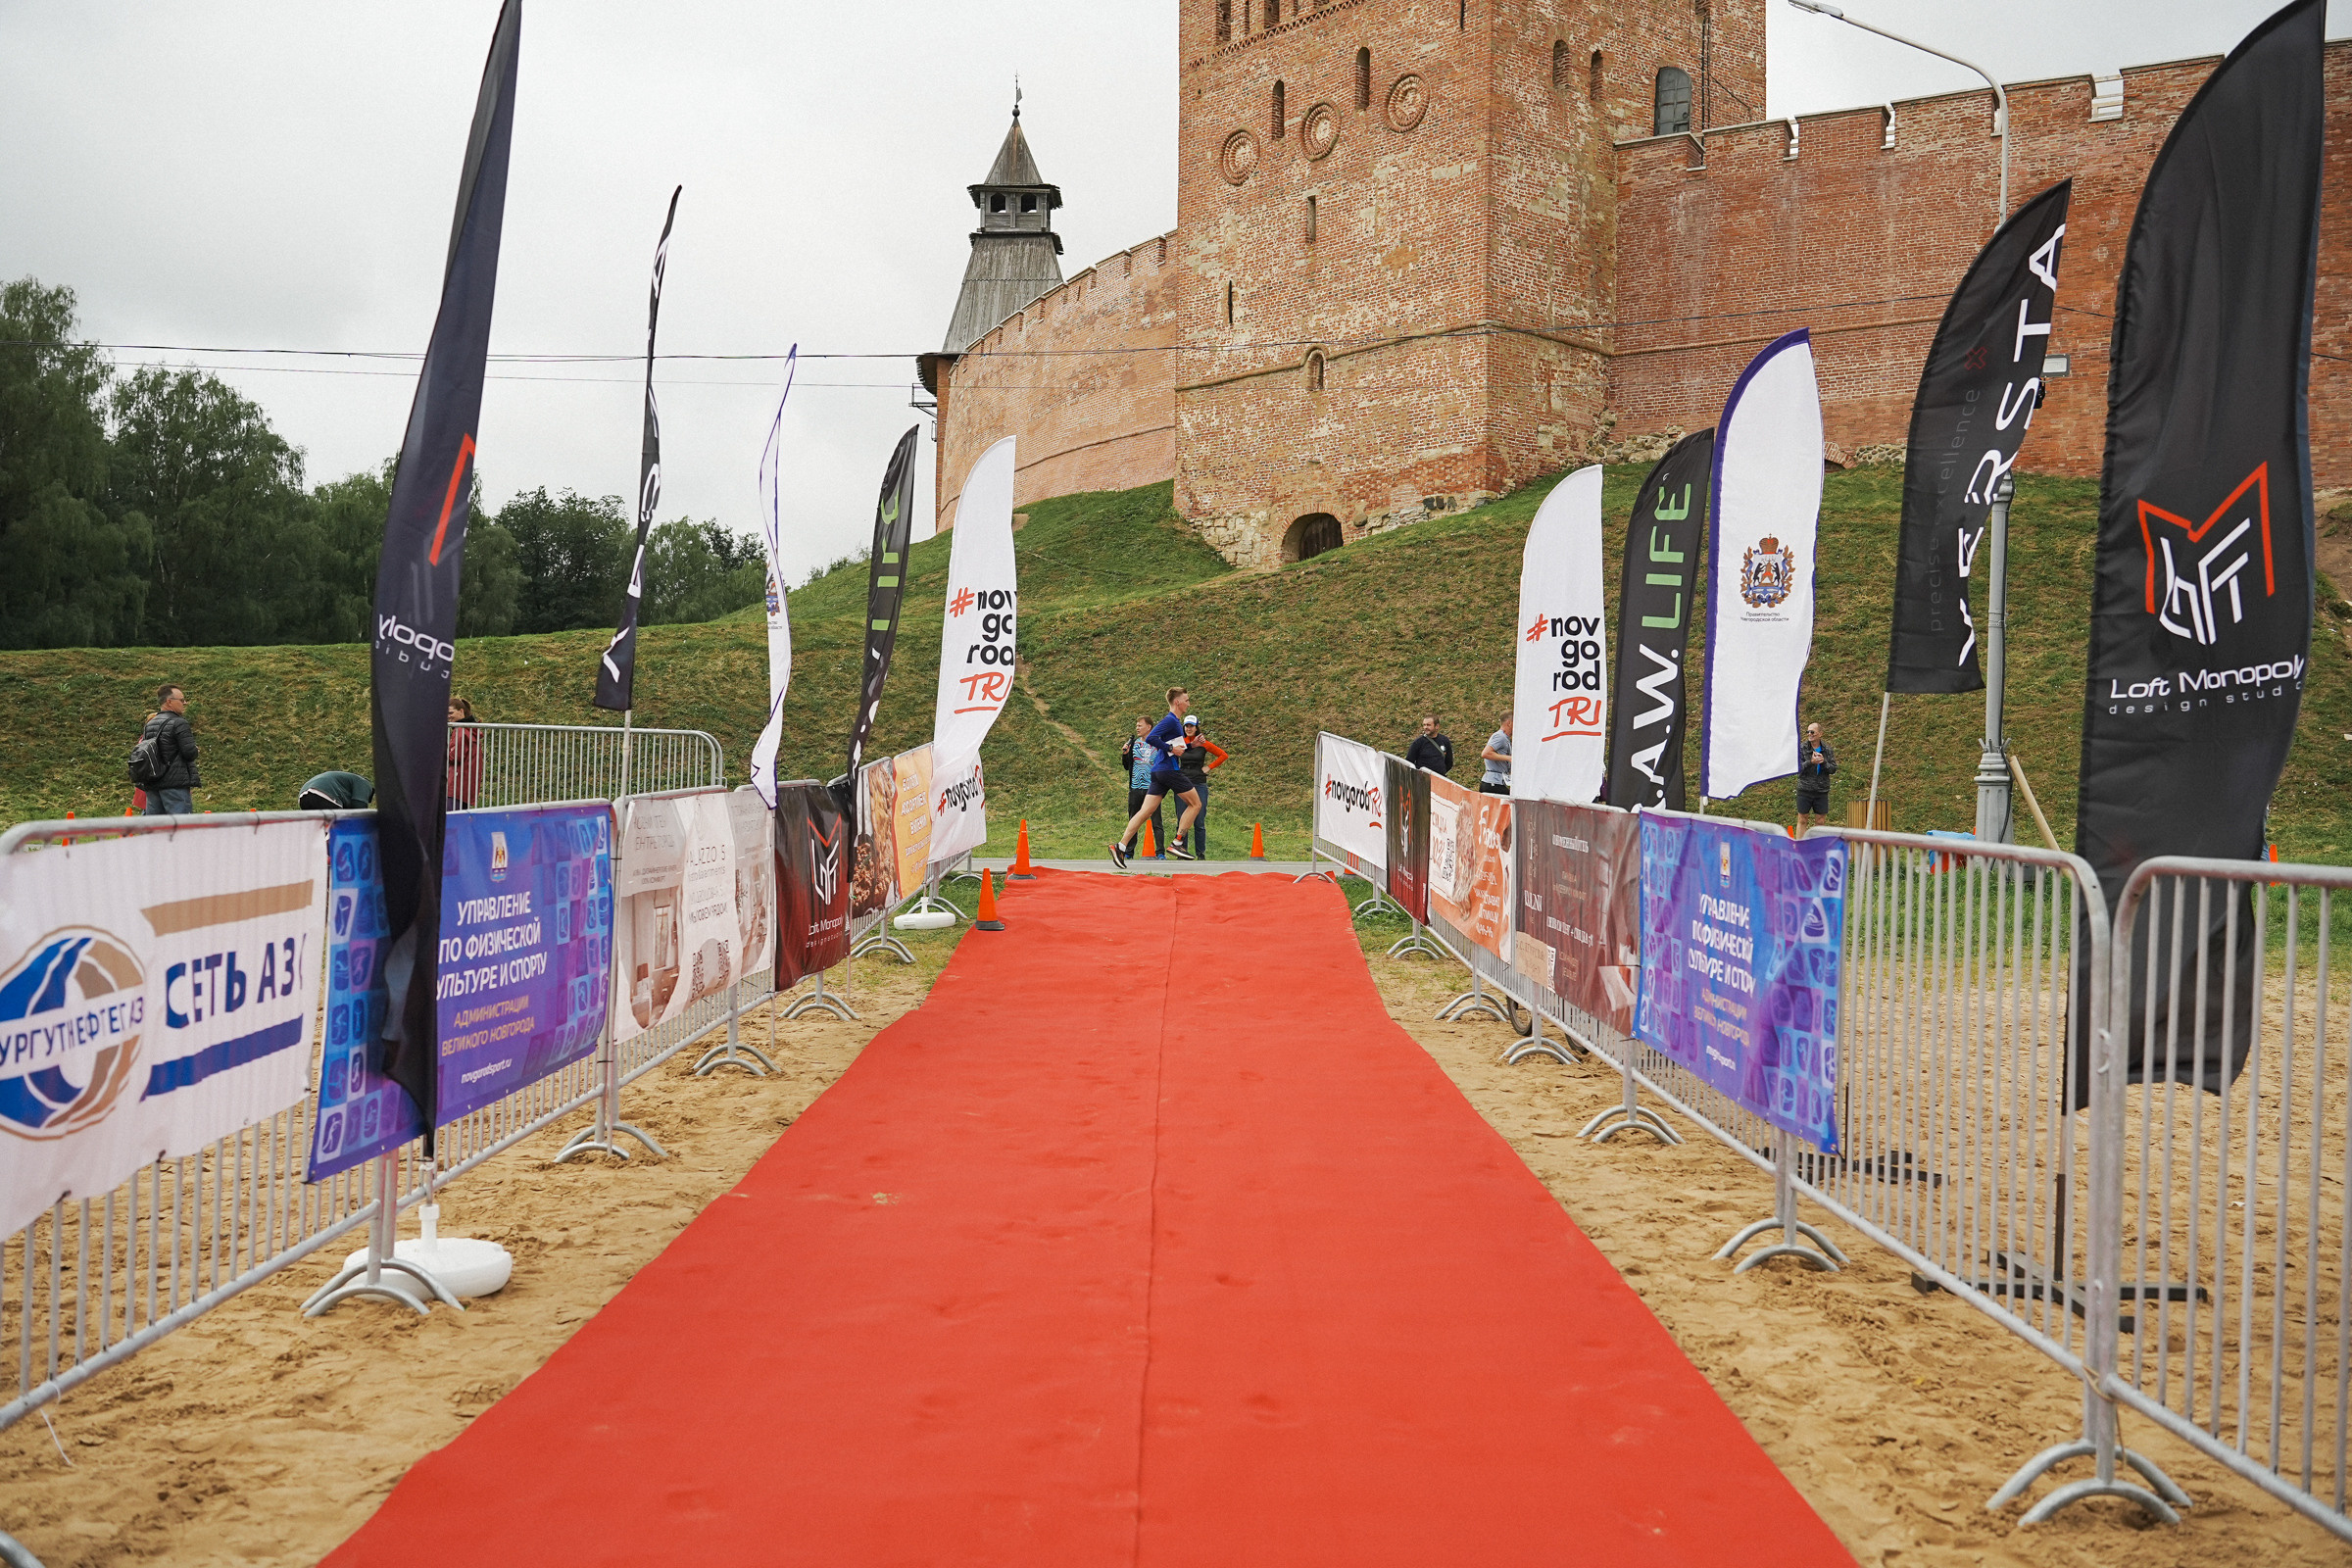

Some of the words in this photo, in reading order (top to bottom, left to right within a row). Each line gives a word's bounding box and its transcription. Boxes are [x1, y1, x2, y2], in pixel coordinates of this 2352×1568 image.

[1642, 483, 1691, 629] LIFE
[1929, 540, 1944, 632] precise
[1526, 613, 1600, 643] #nov
[1561, 641, 1600, 667] go
[1552, 661, 1600, 692] rod
[2110, 677, 2171, 699] Loft
[2179, 654, 2304, 693] Monopoly
[1548, 696, 1601, 728] TRI
[2109, 698, 2208, 715] design
[457, 890, 531, 926] УПРАВЛЕНИЕ
[438, 936, 463, 964] ПО
[465, 917, 542, 960] ФИЗИЧЕСКОЙ
[166, 951, 246, 1030] СЕТЬ
[436, 964, 497, 1001] УЛЬТУРЕ
[500, 966, 509, 987] И
[509, 952, 548, 985] СПОРТУ
[454, 995, 529, 1029] АДМИНИСТРАЦИИ
[441, 1029, 489, 1057] ВЕЛИКОГО
[490, 1016, 535, 1042] НОВГОРОДА
